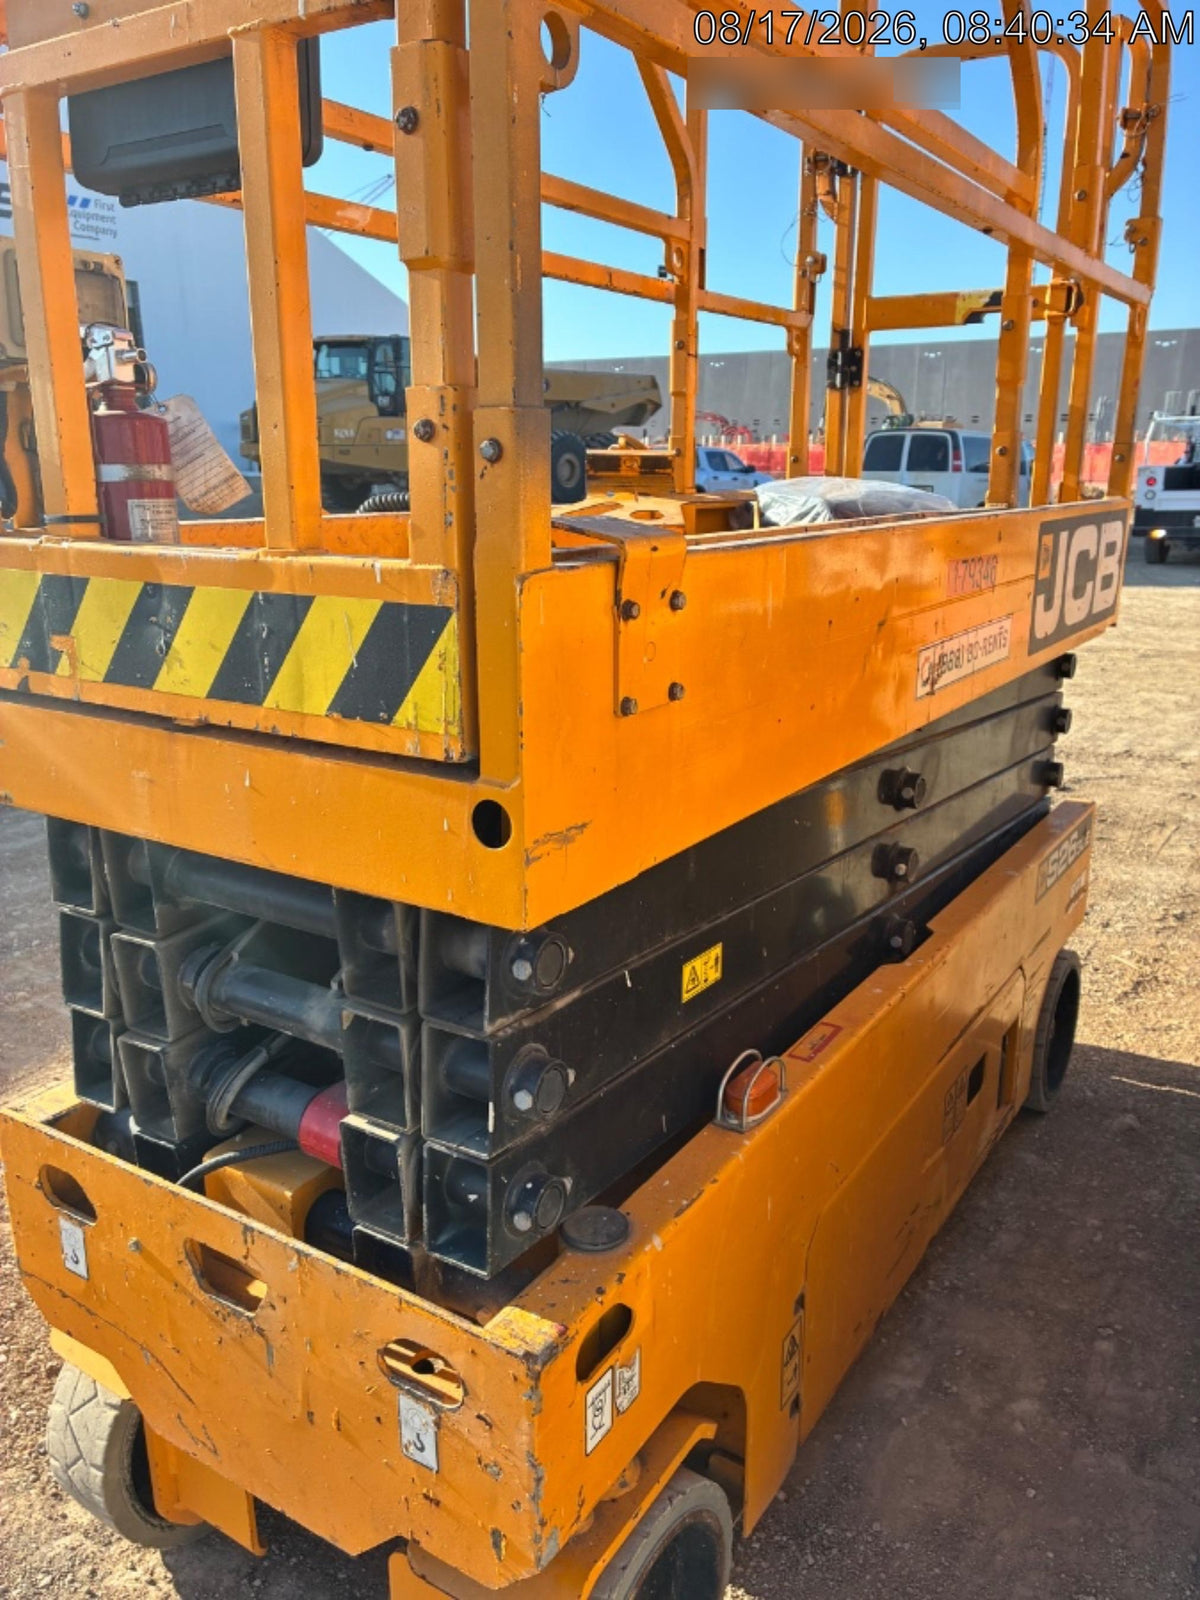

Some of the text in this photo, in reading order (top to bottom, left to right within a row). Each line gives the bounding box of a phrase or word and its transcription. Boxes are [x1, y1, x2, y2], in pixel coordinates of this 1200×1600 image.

[94, 199, 115, 212] First
[69, 209, 117, 225] quipment
[73, 221, 118, 239] Company
[1034, 520, 1124, 640] JCB
